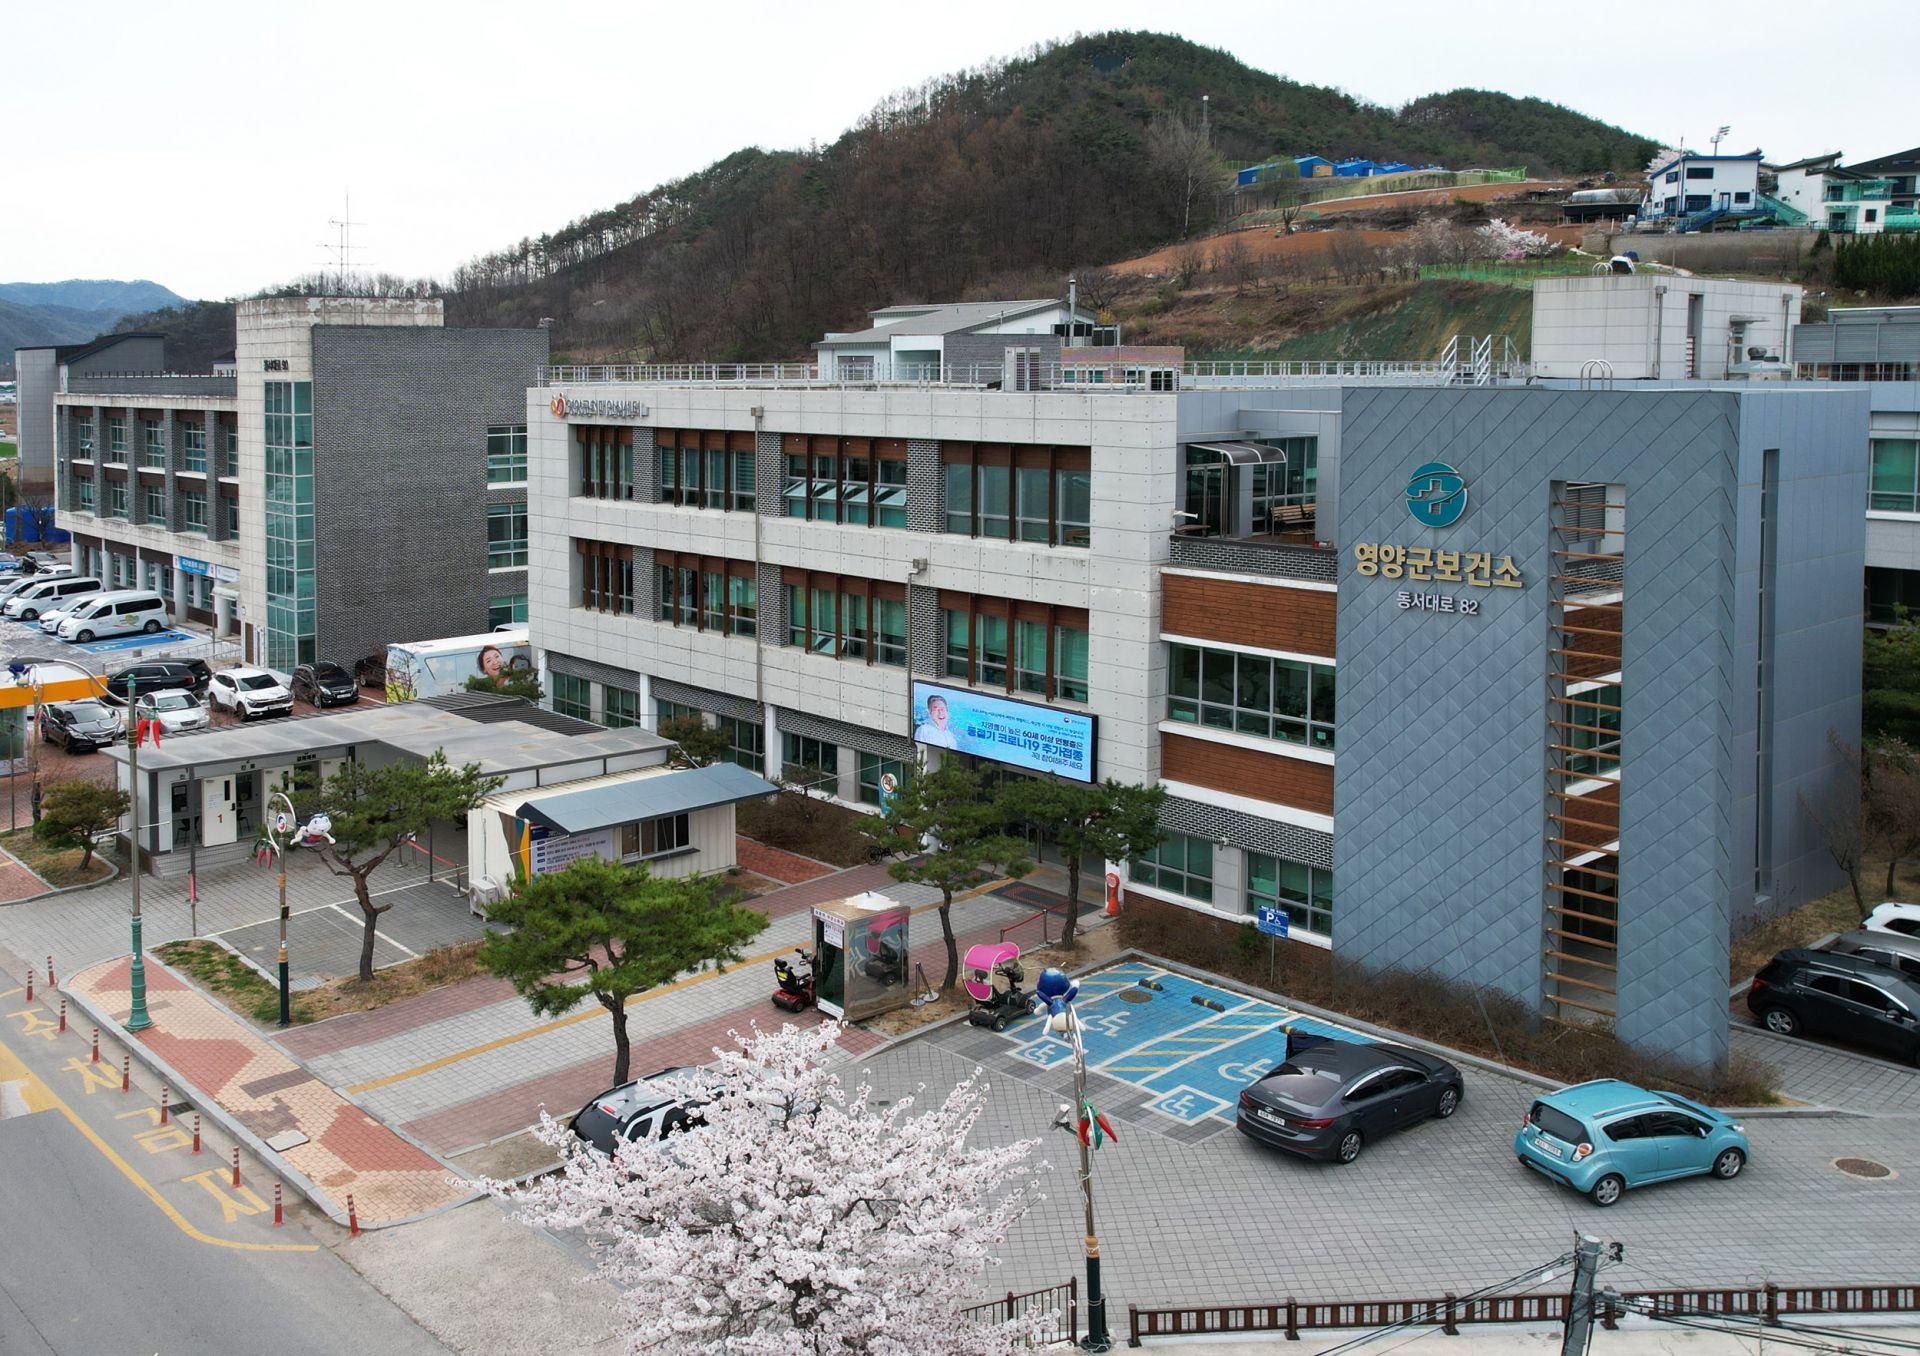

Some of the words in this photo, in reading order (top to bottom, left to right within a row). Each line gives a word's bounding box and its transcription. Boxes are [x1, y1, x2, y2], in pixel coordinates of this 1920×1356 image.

[1355, 543, 1523, 588] 영양군보건소
[1396, 591, 1454, 613] 동서대로
[1459, 599, 1479, 615] 82
[967, 725, 996, 742] 동절기
[997, 732, 1040, 751] 코로나19
[1041, 743, 1083, 761] 추가접종
[1022, 730, 1039, 740] 60세
[1040, 734, 1054, 744] 이상
[1055, 737, 1083, 750] 연령층은
[217, 813, 223, 824] 1
[1266, 912, 1275, 923] P
